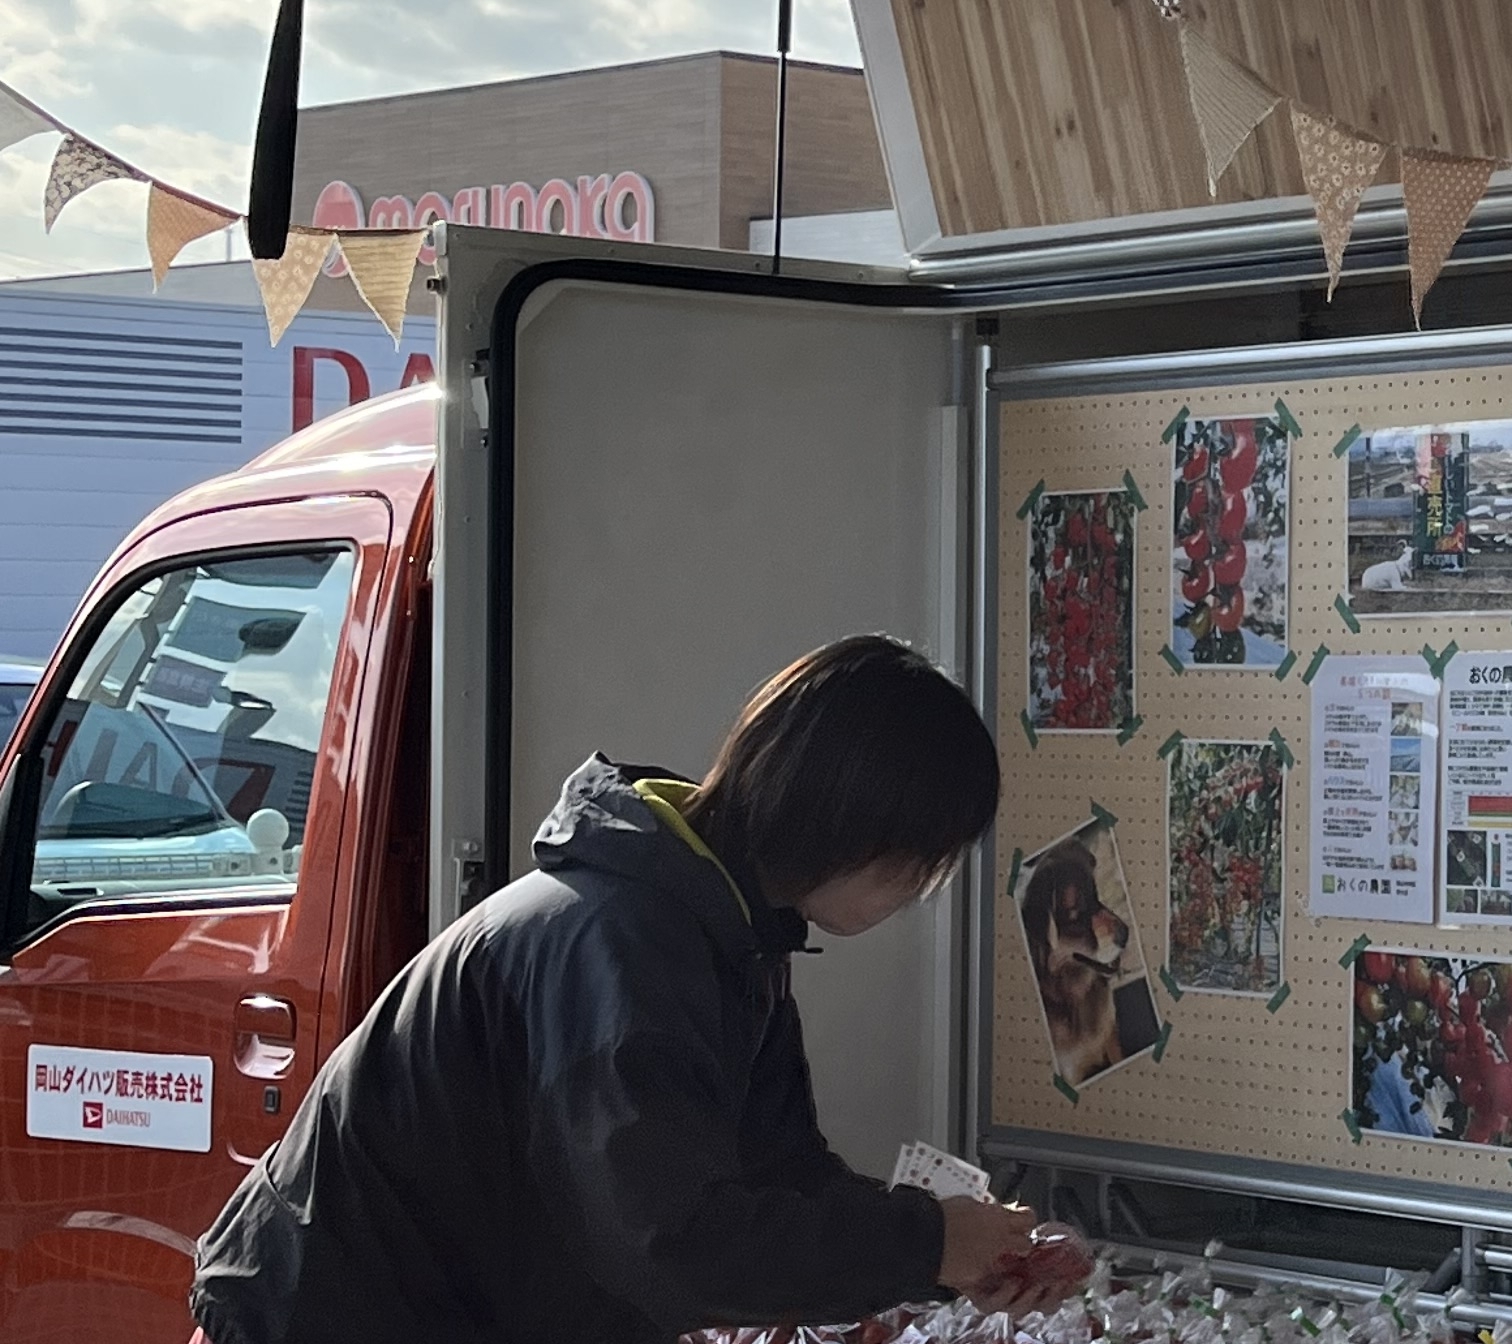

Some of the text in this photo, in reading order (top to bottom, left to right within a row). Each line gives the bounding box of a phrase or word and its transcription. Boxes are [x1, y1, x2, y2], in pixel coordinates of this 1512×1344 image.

[35, 1063, 204, 1104] 岡山ダイハツ販売株式会社
[106, 1107, 151, 1128] DAIHATSU
